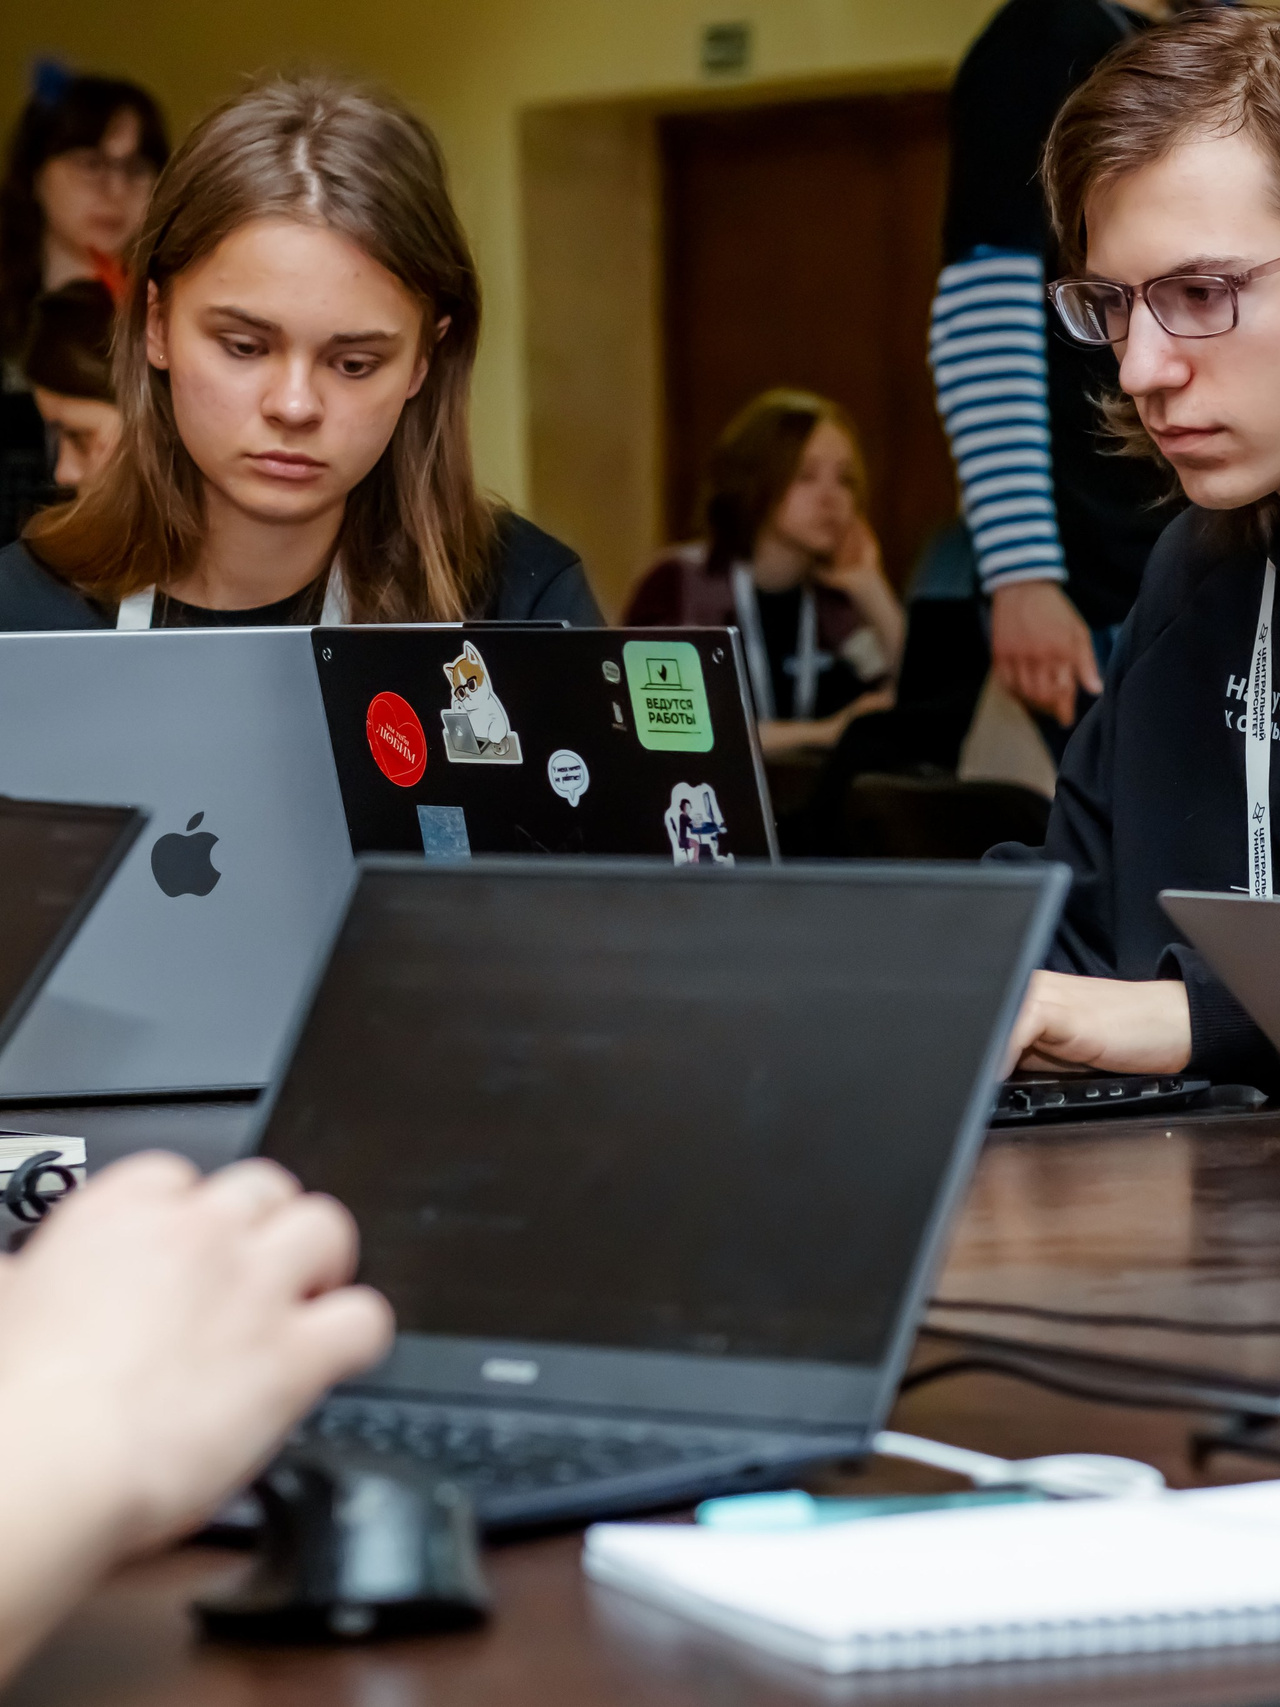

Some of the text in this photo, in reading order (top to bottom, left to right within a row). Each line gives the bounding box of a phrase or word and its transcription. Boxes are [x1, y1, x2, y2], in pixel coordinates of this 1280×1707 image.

[646, 697, 693, 711] ВЕДУТСЯ
[648, 712, 696, 725] РАБОТЫ
[1251, 649, 1262, 738] УНИВЕРСИТЕТ
[1259, 647, 1267, 741] ЦЕНТРАЛЬНЫЙ
[376, 723, 415, 764] ЛЮБИМ
[1253, 829, 1261, 897] УНИВЕРСИ
